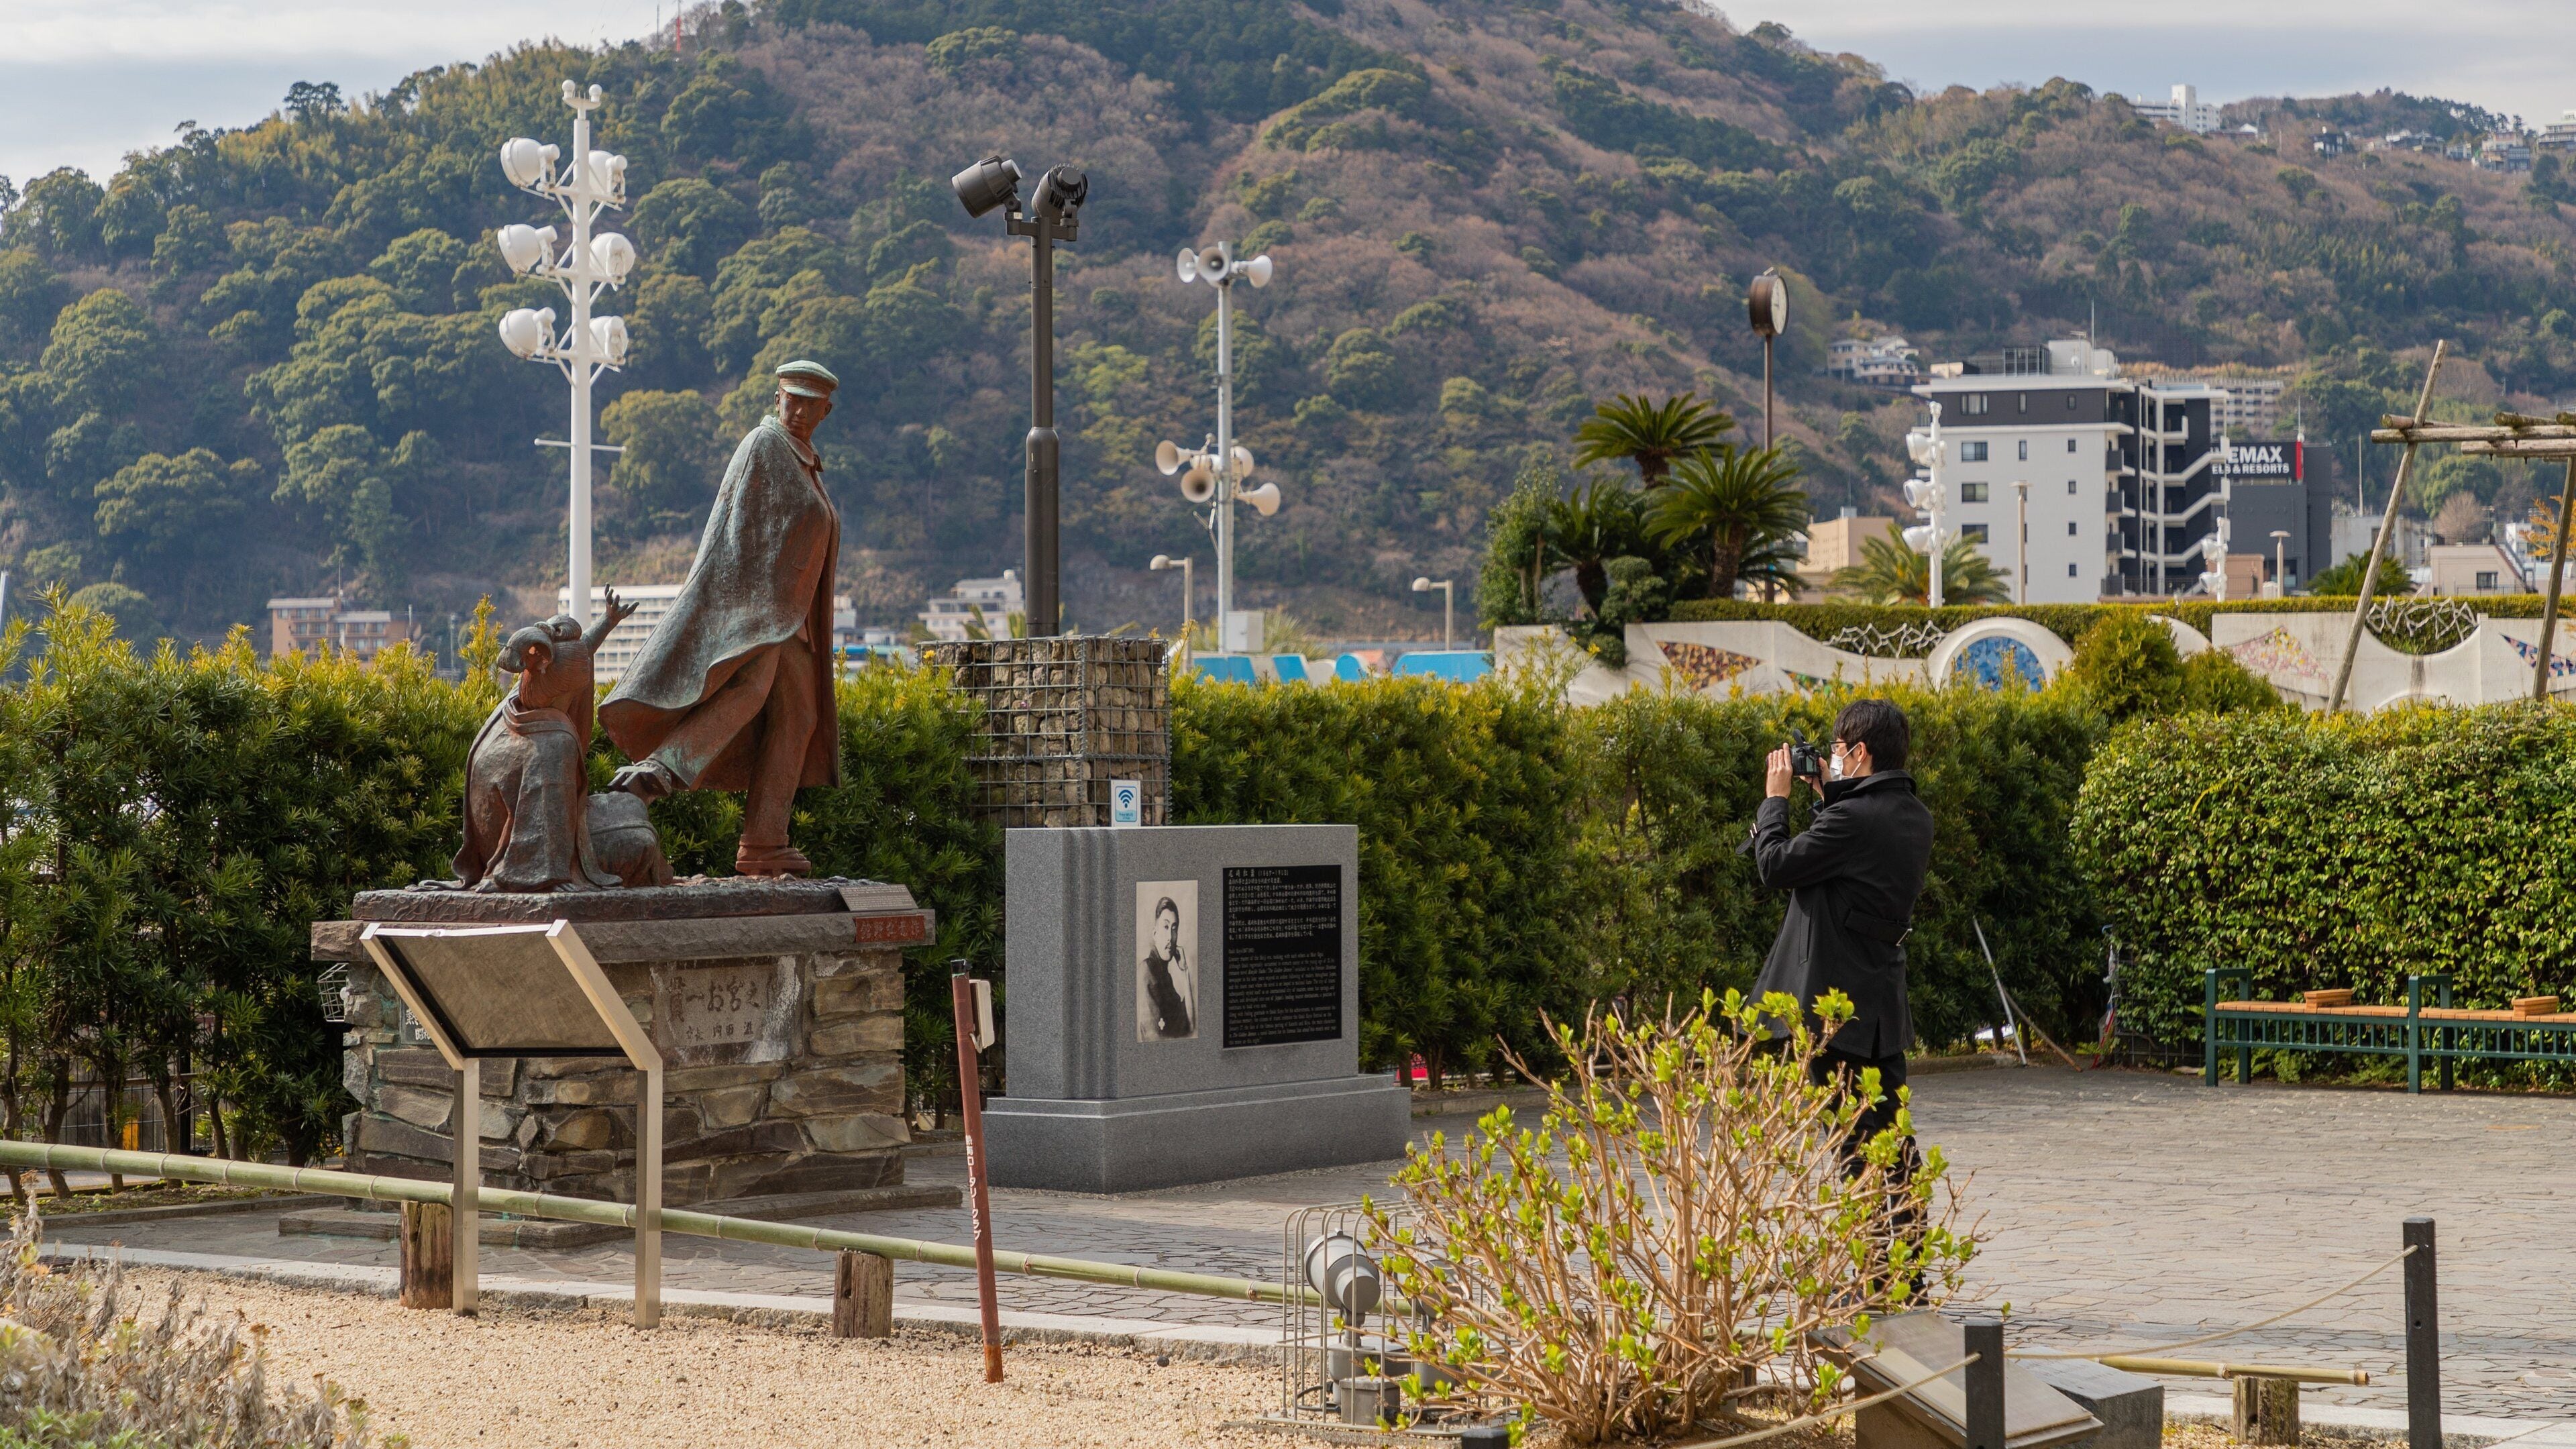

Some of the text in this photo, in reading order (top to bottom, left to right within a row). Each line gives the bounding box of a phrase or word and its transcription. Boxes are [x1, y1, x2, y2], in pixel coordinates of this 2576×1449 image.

[2232, 463, 2241, 475] &
[2242, 463, 2290, 474] RESORTS
[405, 1009, 421, 1026] 熱
